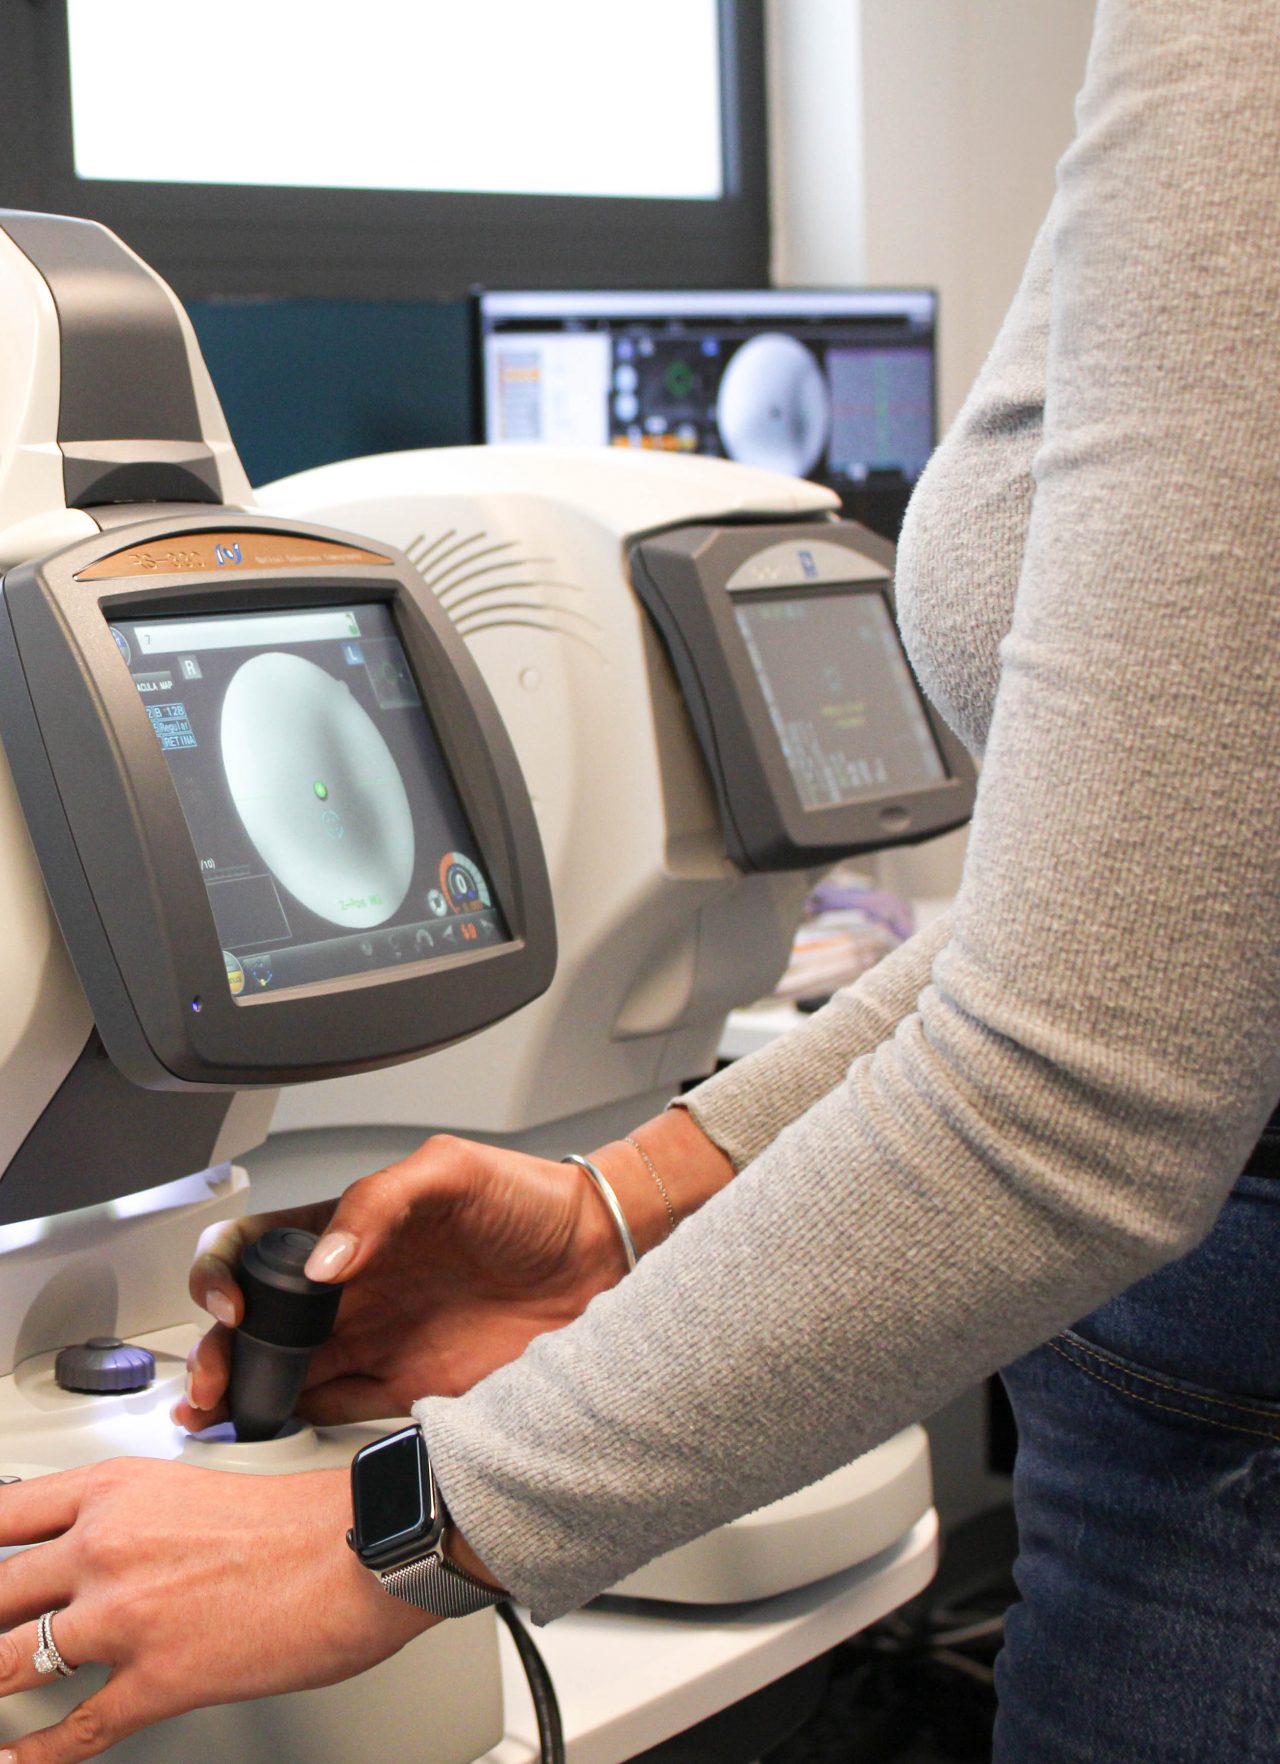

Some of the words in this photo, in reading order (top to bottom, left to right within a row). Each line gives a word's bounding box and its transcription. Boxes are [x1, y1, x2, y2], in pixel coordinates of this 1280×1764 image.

[346, 645, 358, 661] L
[184, 660, 197, 676] R
[137, 680, 159, 692] ACULA
[166, 705, 185, 717] 128
[164, 735, 195, 748] RETINA
[455, 873, 467, 894] 0
